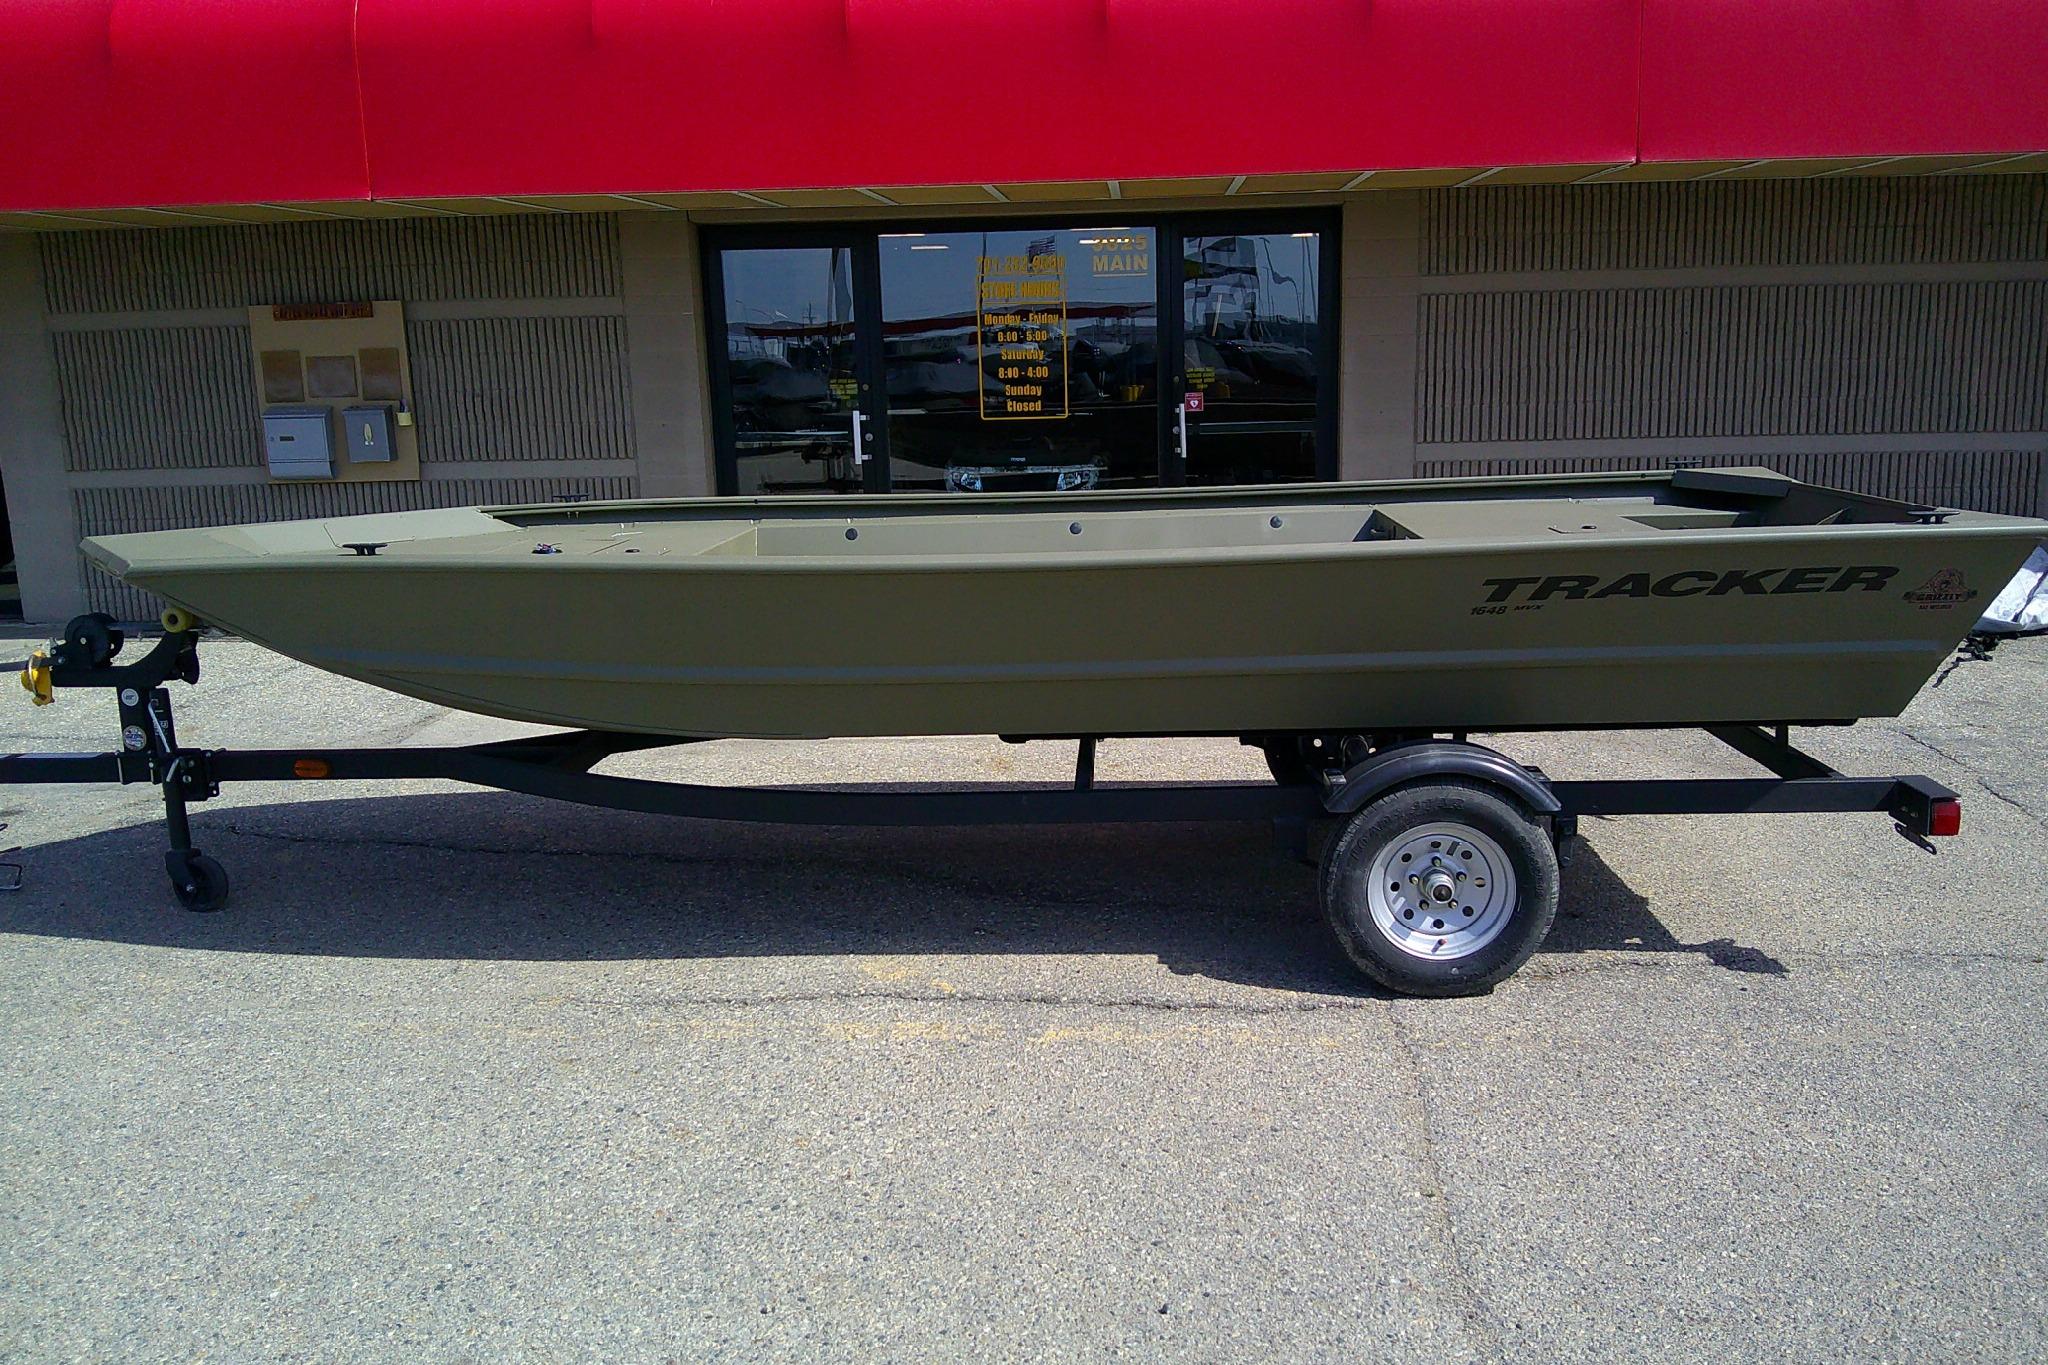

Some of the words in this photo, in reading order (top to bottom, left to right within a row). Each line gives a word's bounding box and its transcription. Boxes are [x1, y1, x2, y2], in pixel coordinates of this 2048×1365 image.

[1093, 254, 1148, 272] MAIN
[984, 312, 1021, 325] Monday
[1029, 312, 1059, 325] Friday
[1026, 330, 1047, 341] 5:00
[1001, 348, 1044, 361] Saturday
[998, 367, 1019, 379] 8:00
[1027, 366, 1049, 378] 4:00
[1005, 384, 1042, 397] Sunday
[1006, 399, 1042, 412] Closed
[1481, 564, 1900, 602] TRACKER
[1470, 605, 1508, 616] 1648
